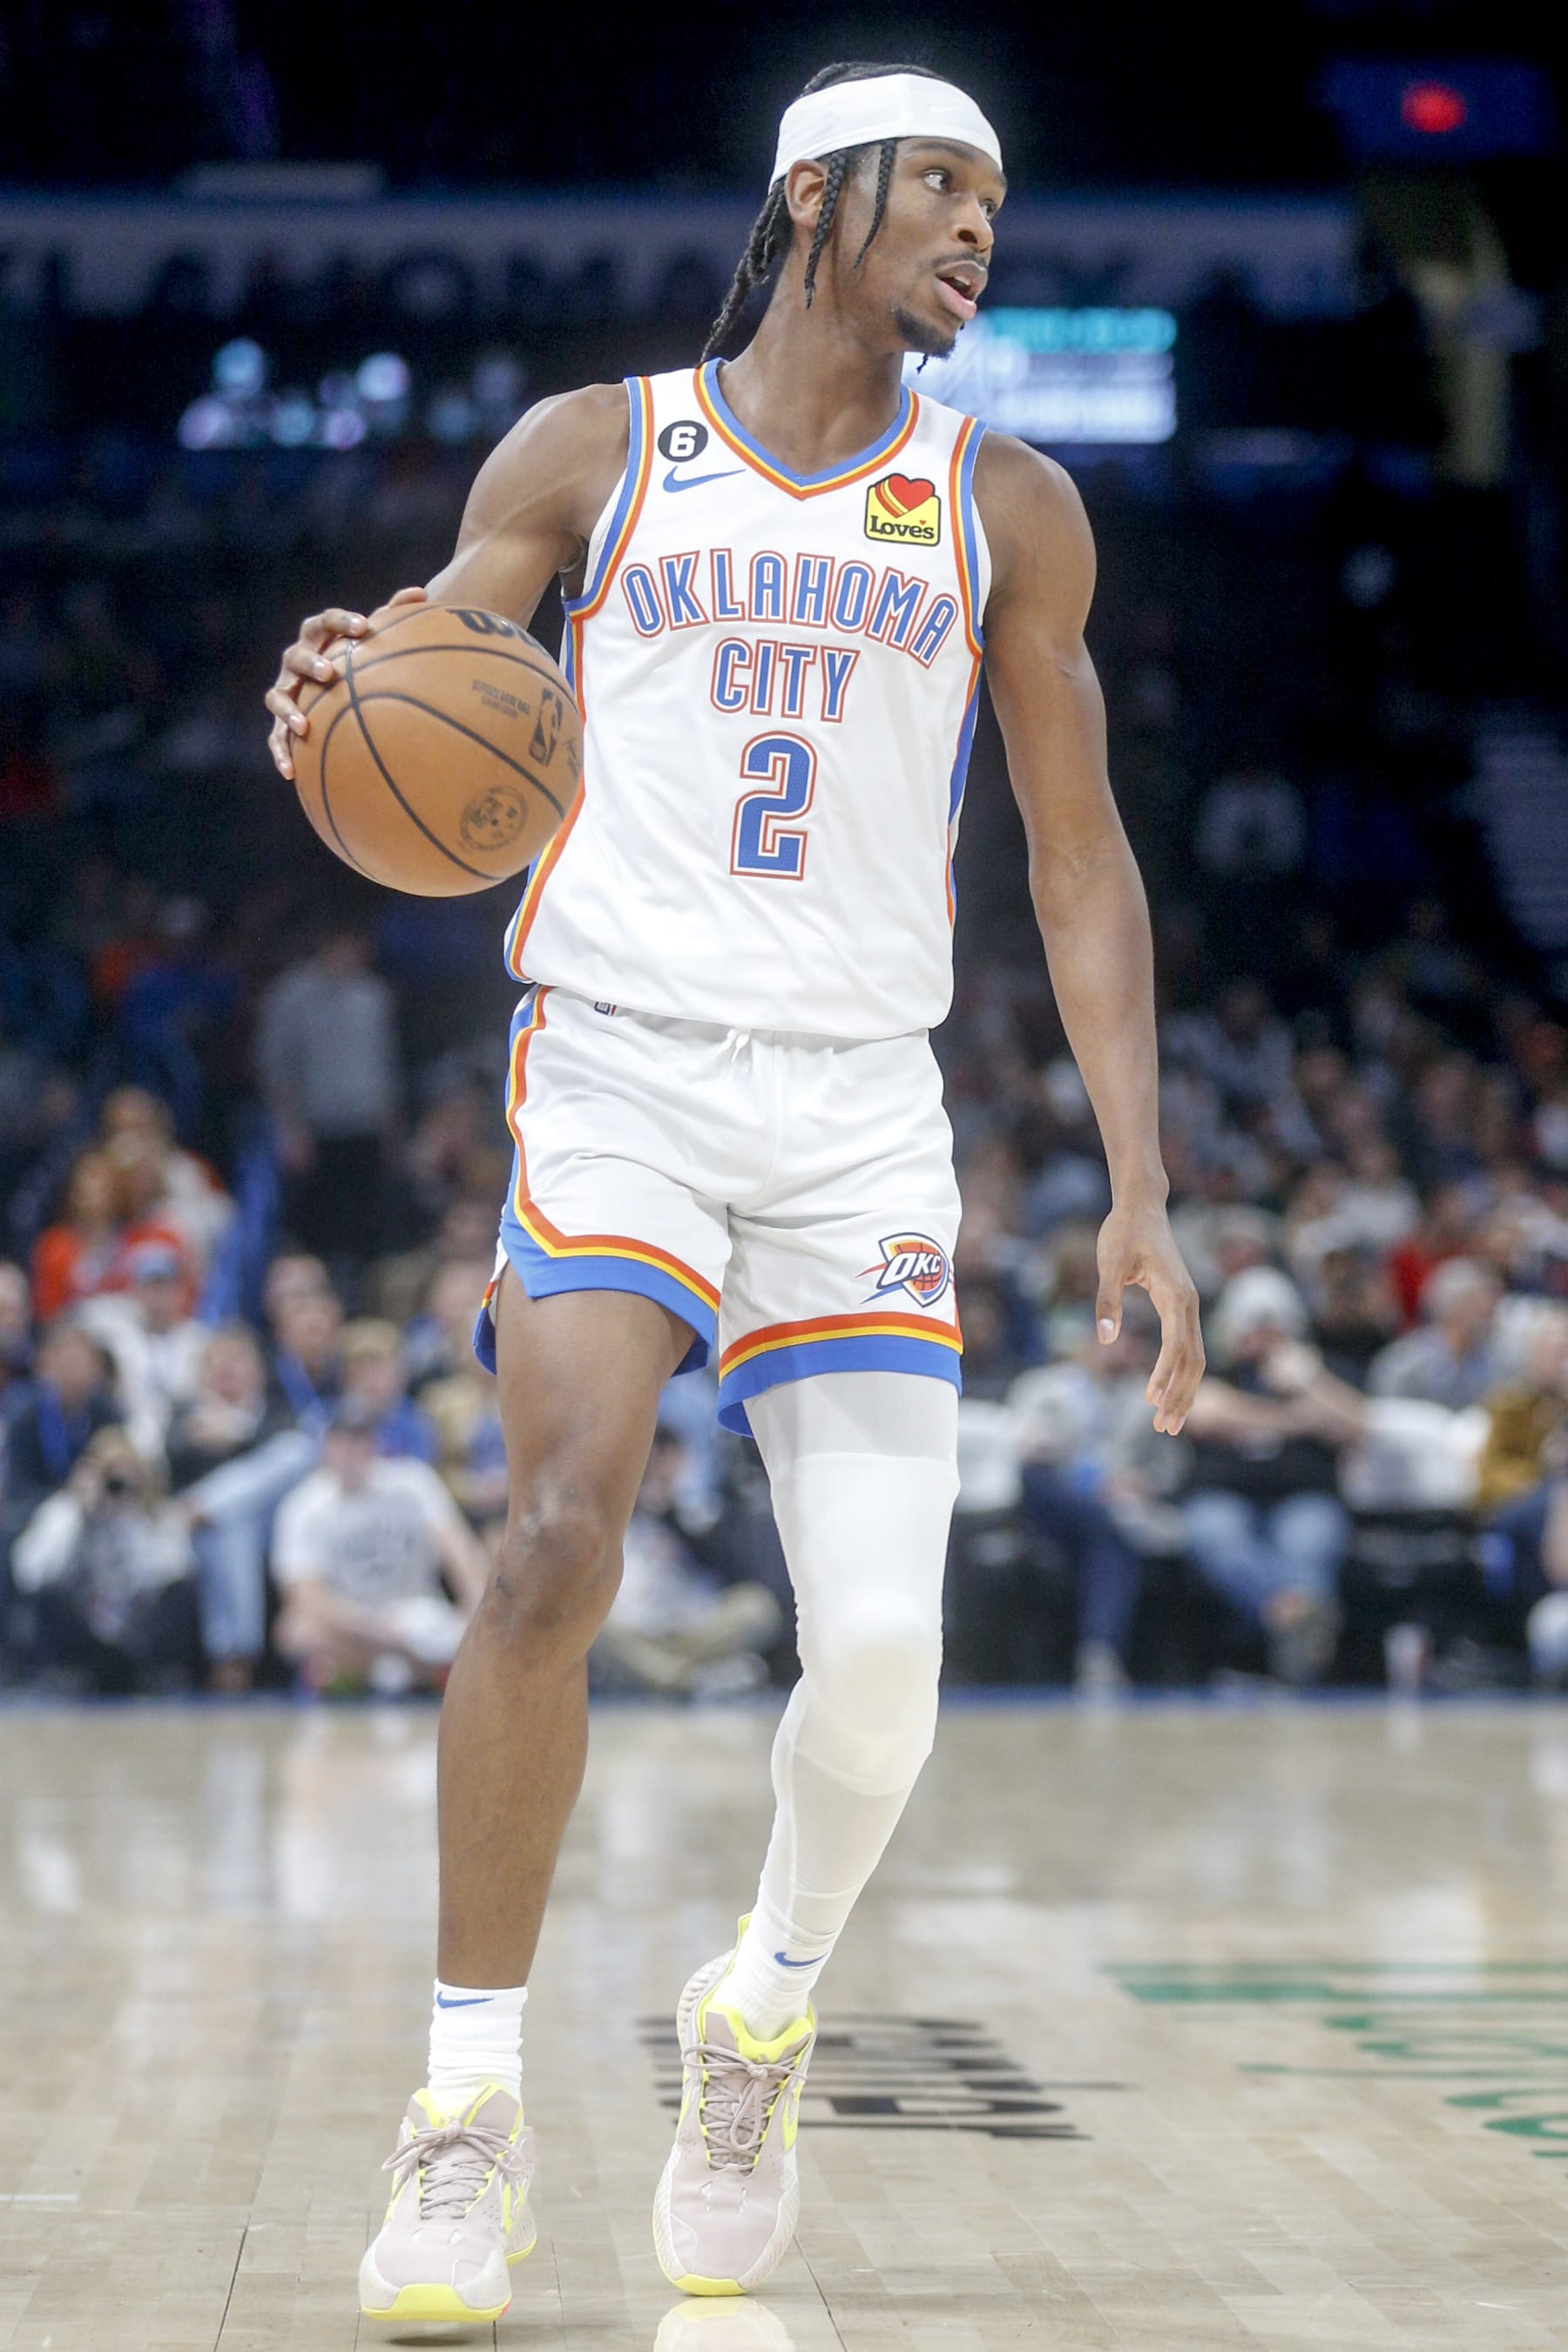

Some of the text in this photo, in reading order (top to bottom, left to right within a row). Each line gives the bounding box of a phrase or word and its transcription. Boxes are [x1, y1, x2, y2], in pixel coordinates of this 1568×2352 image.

[668, 426, 698, 457] 6
[620, 548, 959, 669] OKLAHOMA
[710, 637, 861, 723] CITY
[730, 730, 817, 881] 2
[878, 1251, 943, 1288] OKC
